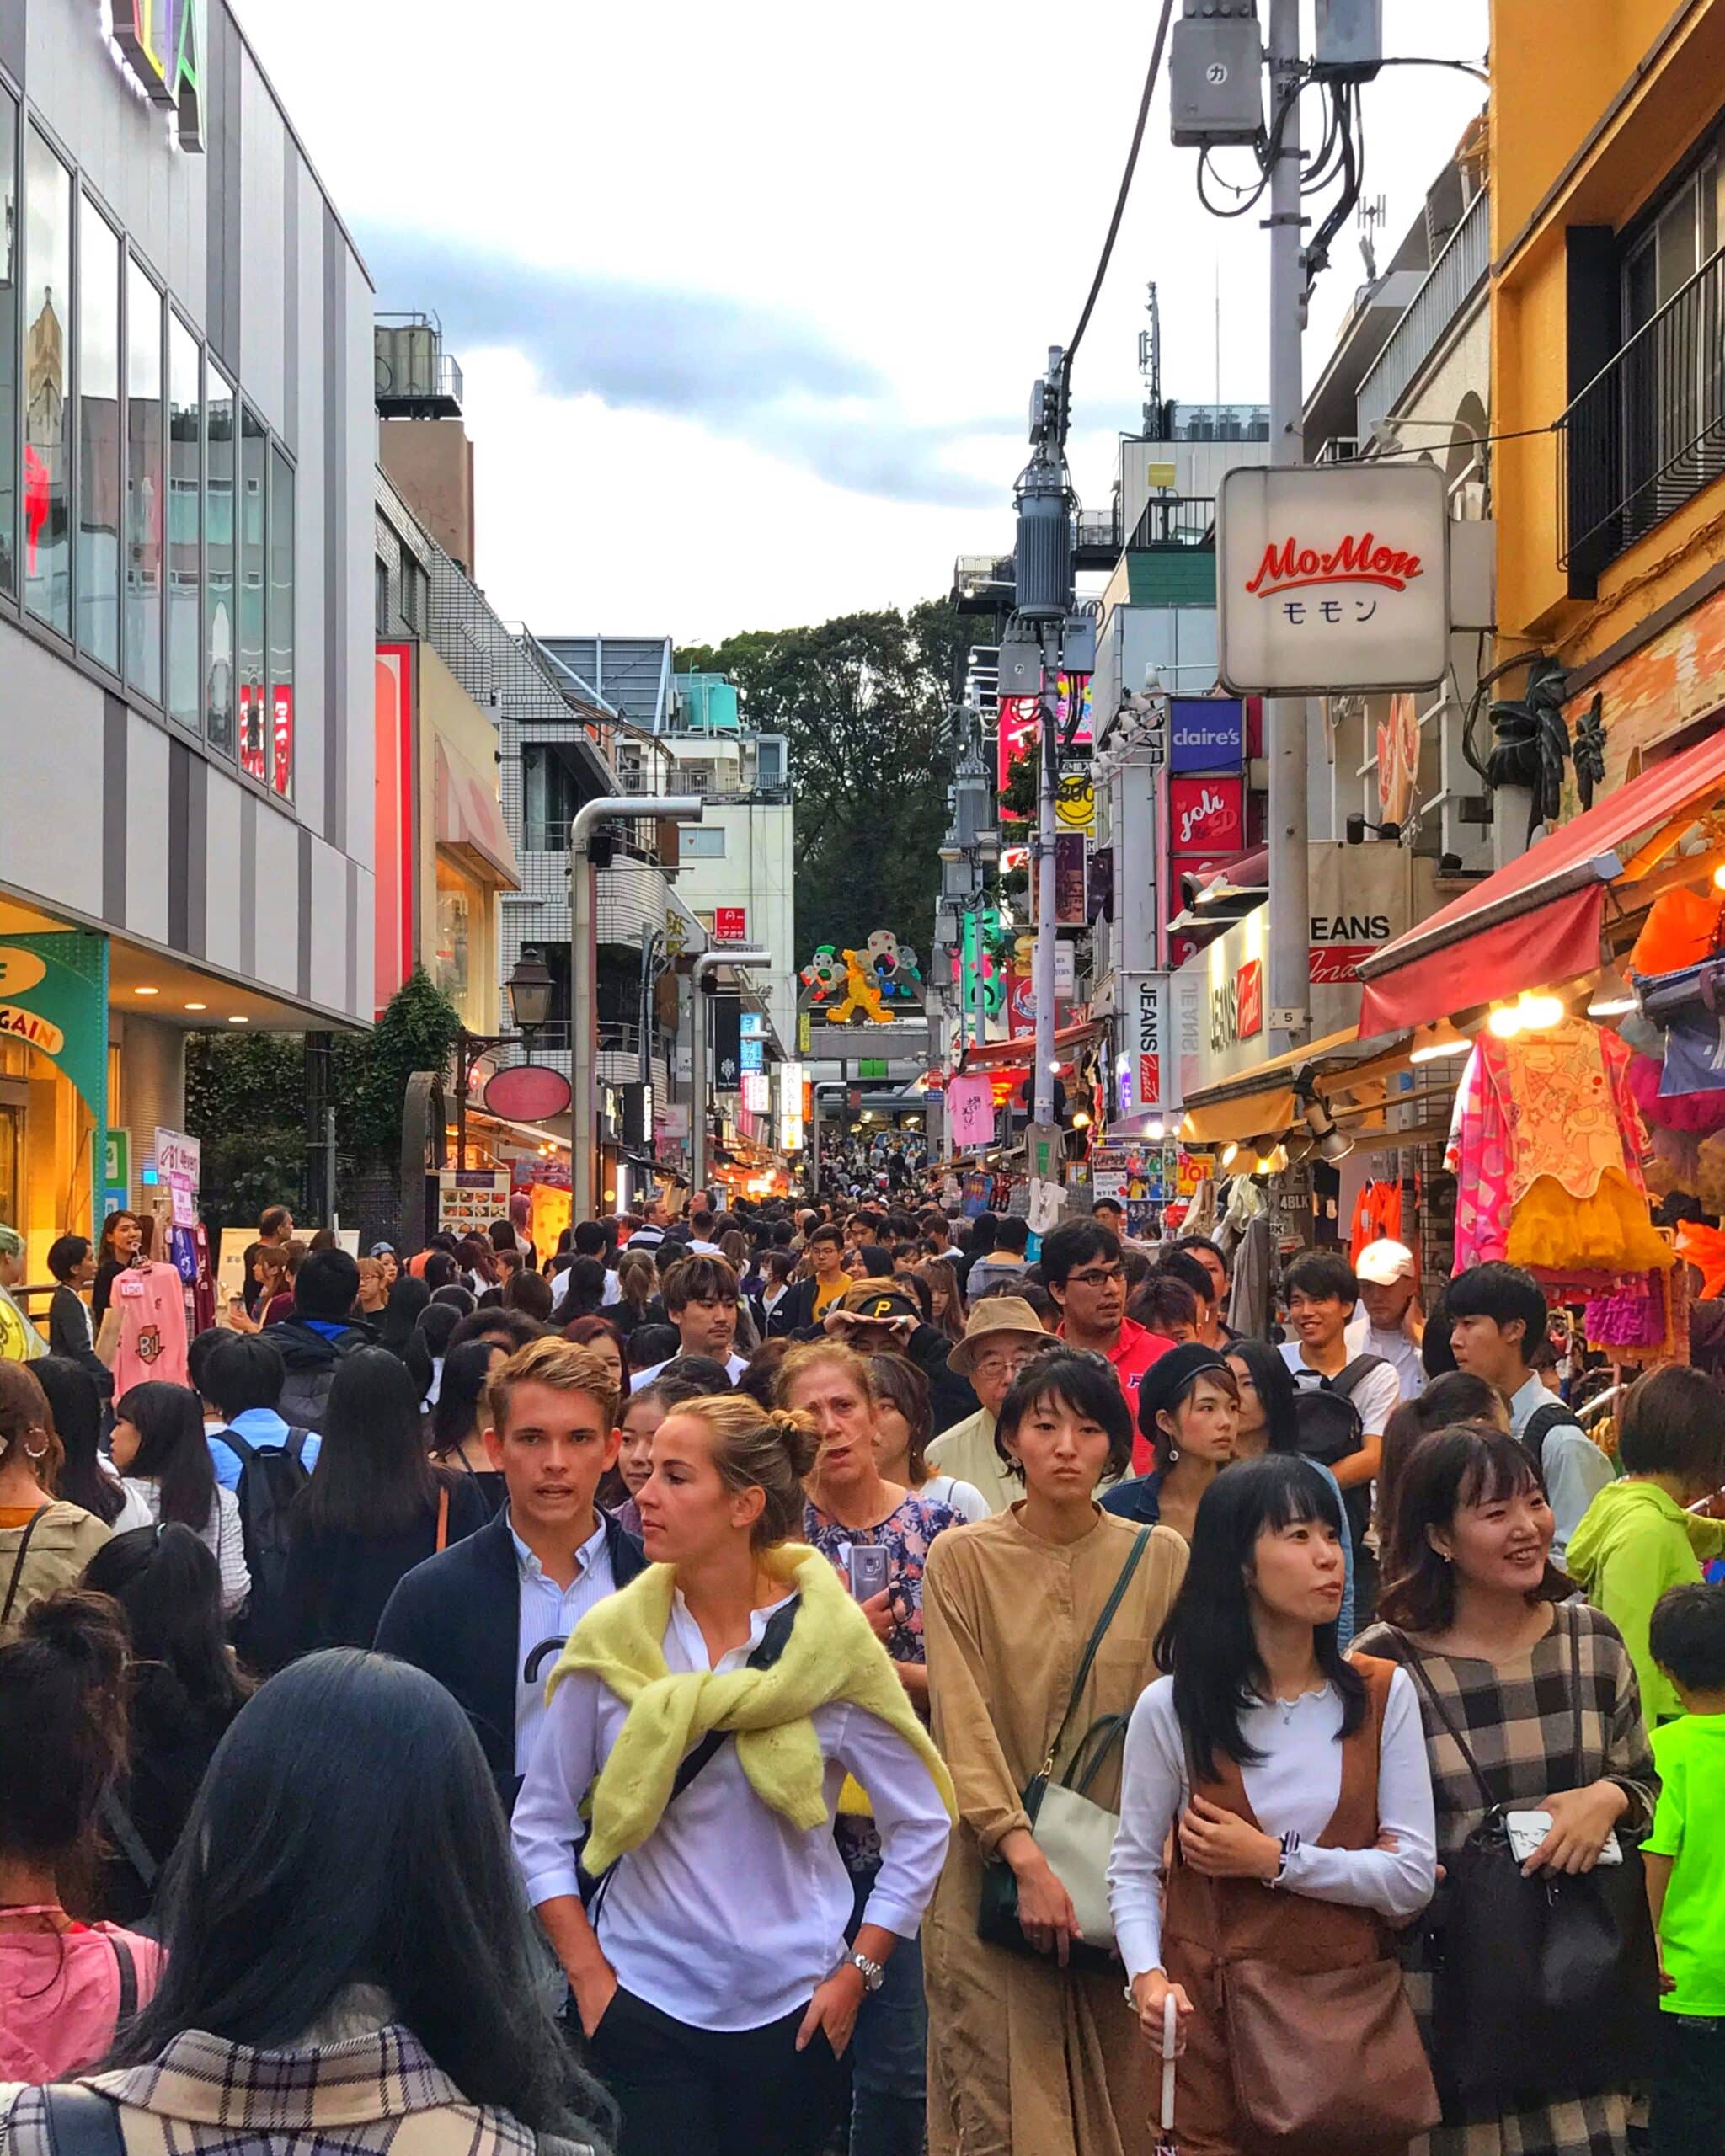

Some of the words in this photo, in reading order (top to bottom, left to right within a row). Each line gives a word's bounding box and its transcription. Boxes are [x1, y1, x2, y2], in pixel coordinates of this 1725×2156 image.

[1282, 600, 1377, 625] モモン
[1172, 728, 1241, 745] claire's
[1180, 788, 1224, 842] joli
[1311, 915, 1390, 941] EANS
[1140, 982, 1158, 1052] JEANS
[1284, 1012, 1293, 1022] 5
[874, 1300, 891, 1317] P
